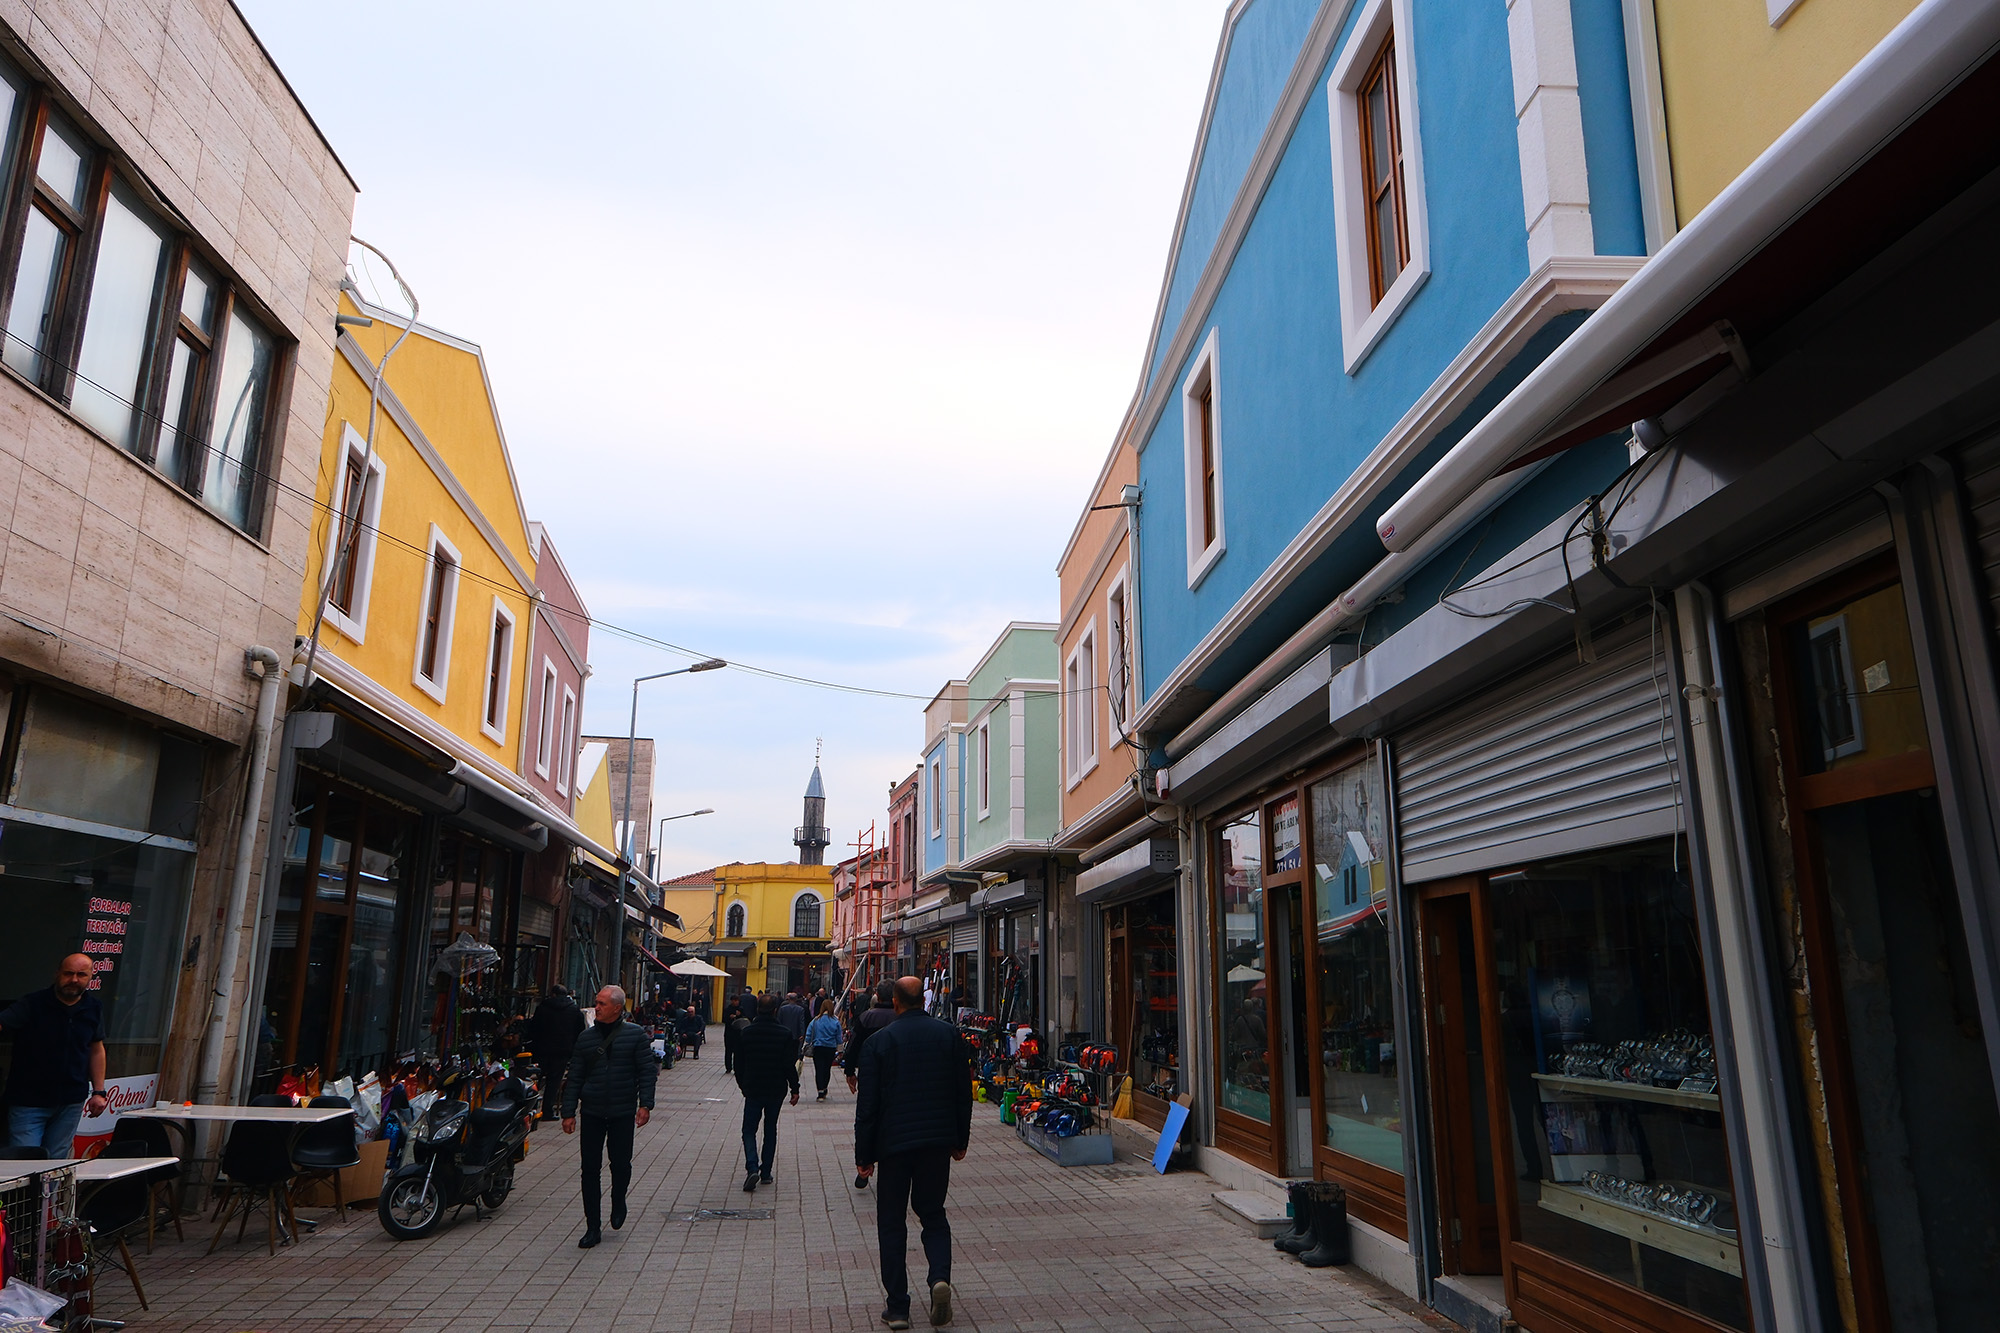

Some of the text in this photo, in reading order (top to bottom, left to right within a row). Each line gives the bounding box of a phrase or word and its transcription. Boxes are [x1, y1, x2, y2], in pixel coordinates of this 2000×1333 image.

[88, 896, 132, 915] ÇORBALAR
[86, 918, 127, 935] TEREYAĞLI
[82, 939, 124, 954] Mercimek
[92, 957, 115, 975] gelin
[105, 1085, 149, 1114] Rahmi
